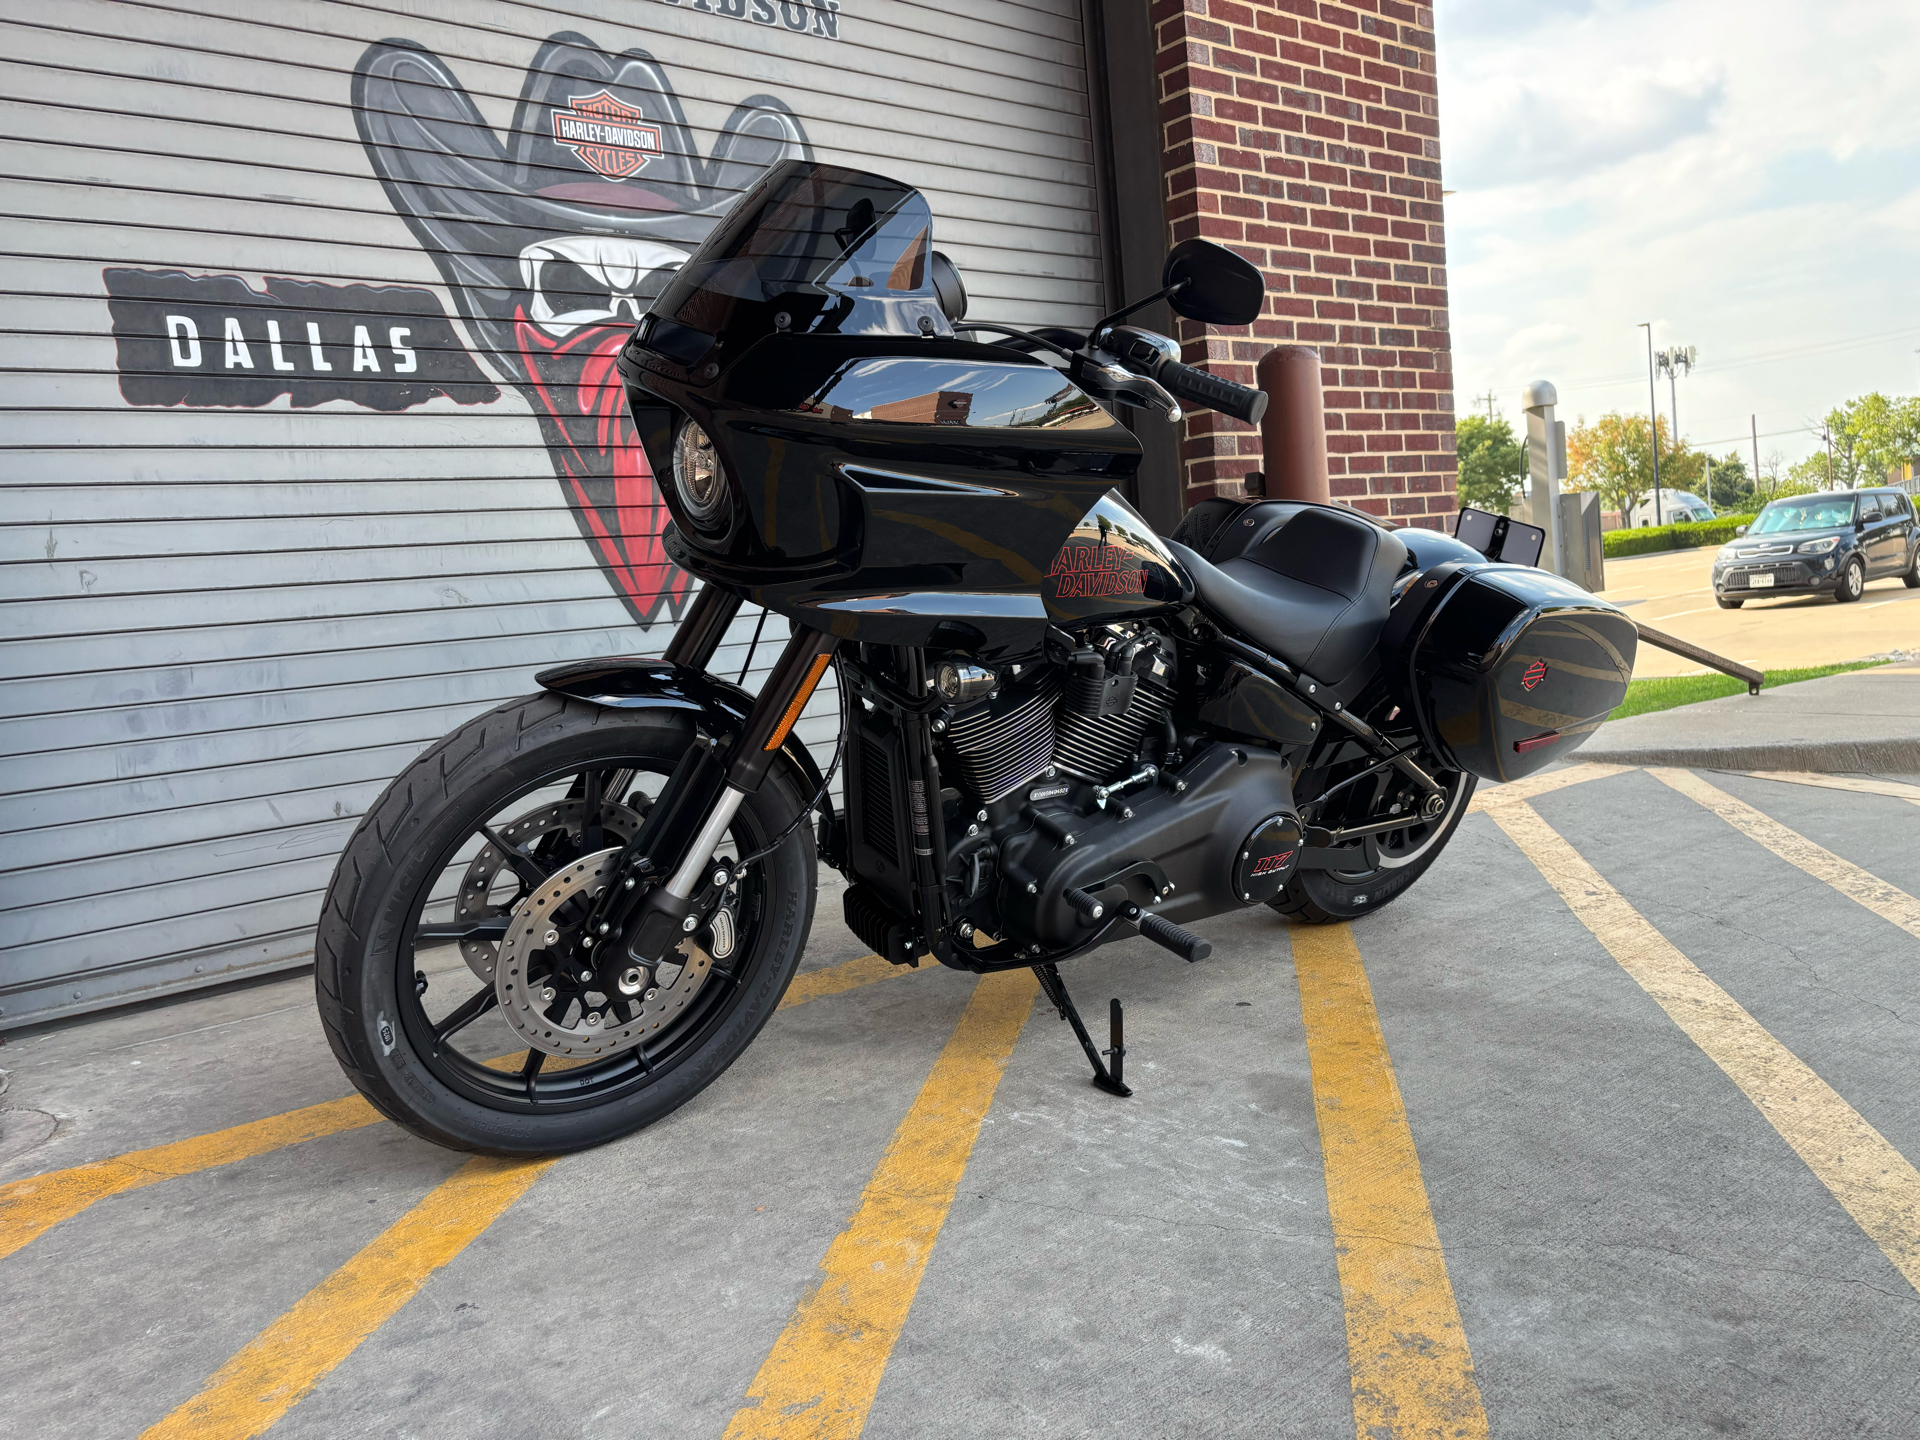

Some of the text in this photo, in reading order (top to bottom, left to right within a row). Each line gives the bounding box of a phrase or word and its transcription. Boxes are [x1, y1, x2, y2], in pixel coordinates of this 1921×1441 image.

[581, 99, 632, 124] MOTOR
[561, 119, 656, 150] HARLEY-DAVIDSON
[585, 147, 636, 173] CYCLES
[165, 314, 418, 373] DALLAS
[1044, 545, 1134, 578] ARLEY-
[1055, 569, 1149, 598] DAVIDSON
[1253, 850, 1294, 873] 117
